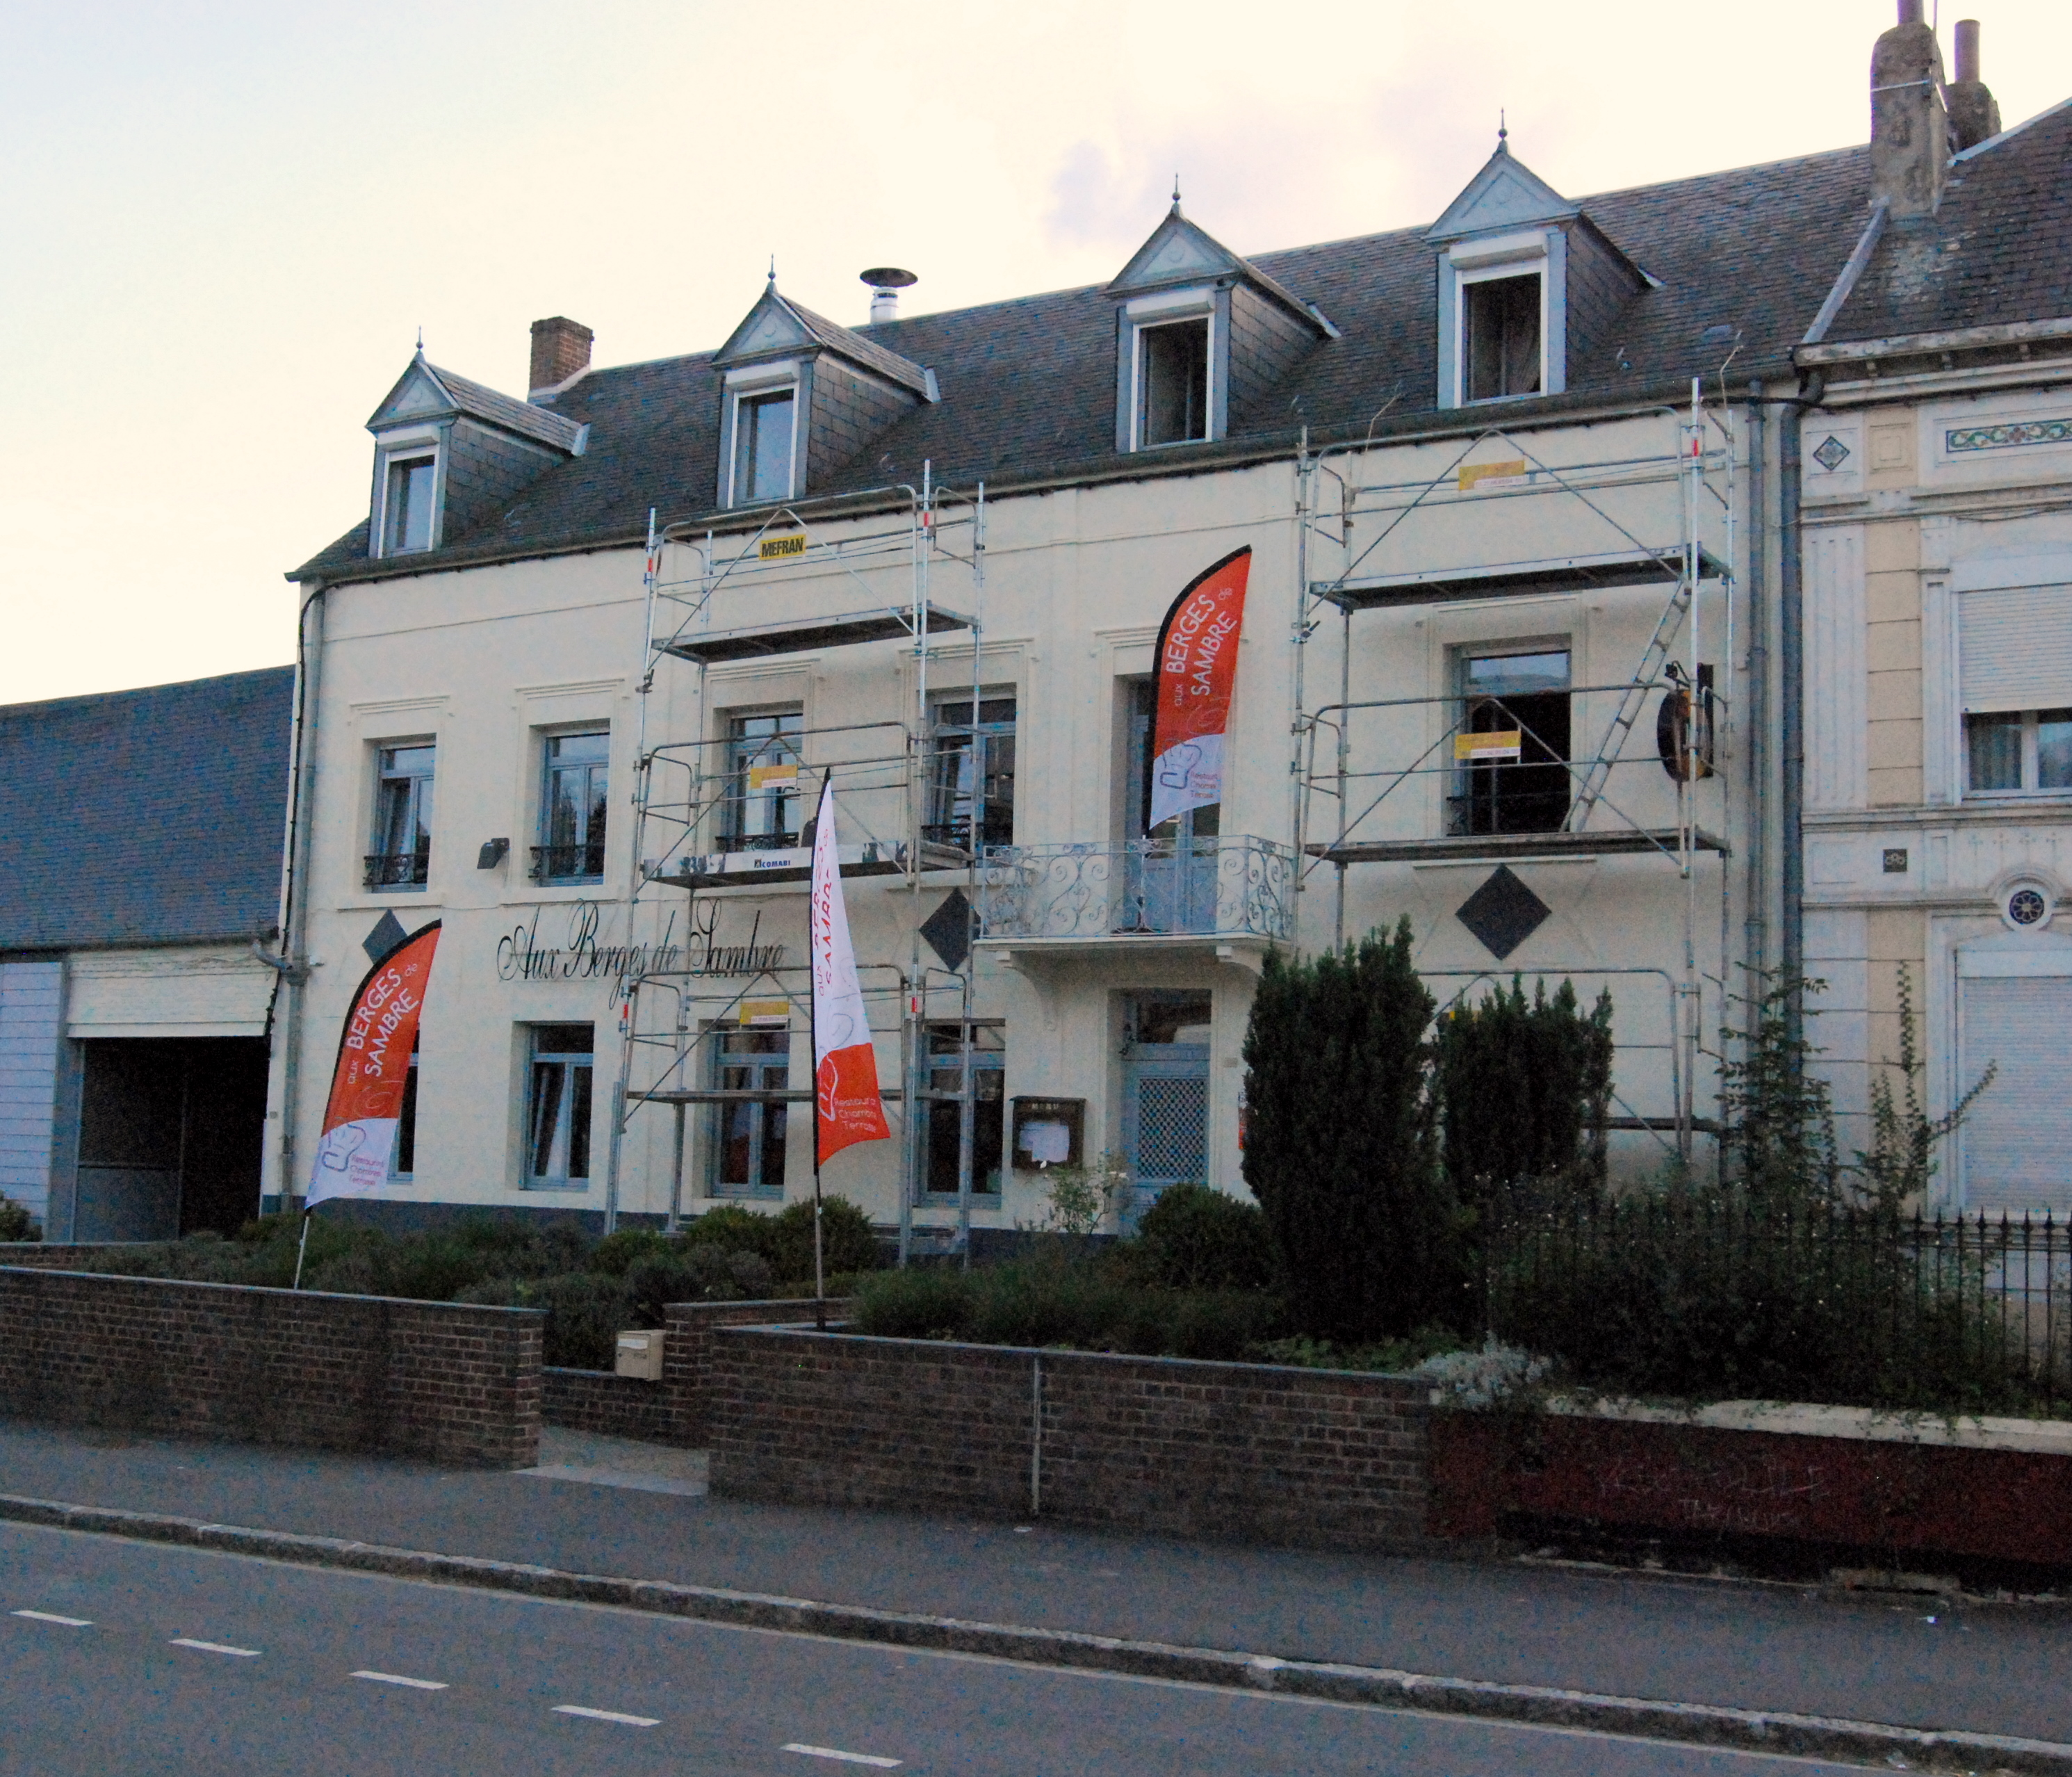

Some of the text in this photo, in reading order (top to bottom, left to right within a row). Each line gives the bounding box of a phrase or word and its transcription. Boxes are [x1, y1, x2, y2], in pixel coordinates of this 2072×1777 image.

[762, 537, 803, 557] MEFRAN
[1166, 594, 1215, 674] BERGES
[1218, 587, 1233, 601] de
[1191, 610, 1237, 697] SAMBRE
[497, 897, 786, 1010] Aux Berges de Sambre
[347, 964, 418, 1085] aux BERGES de
[365, 988, 419, 1077] SAMBRE
